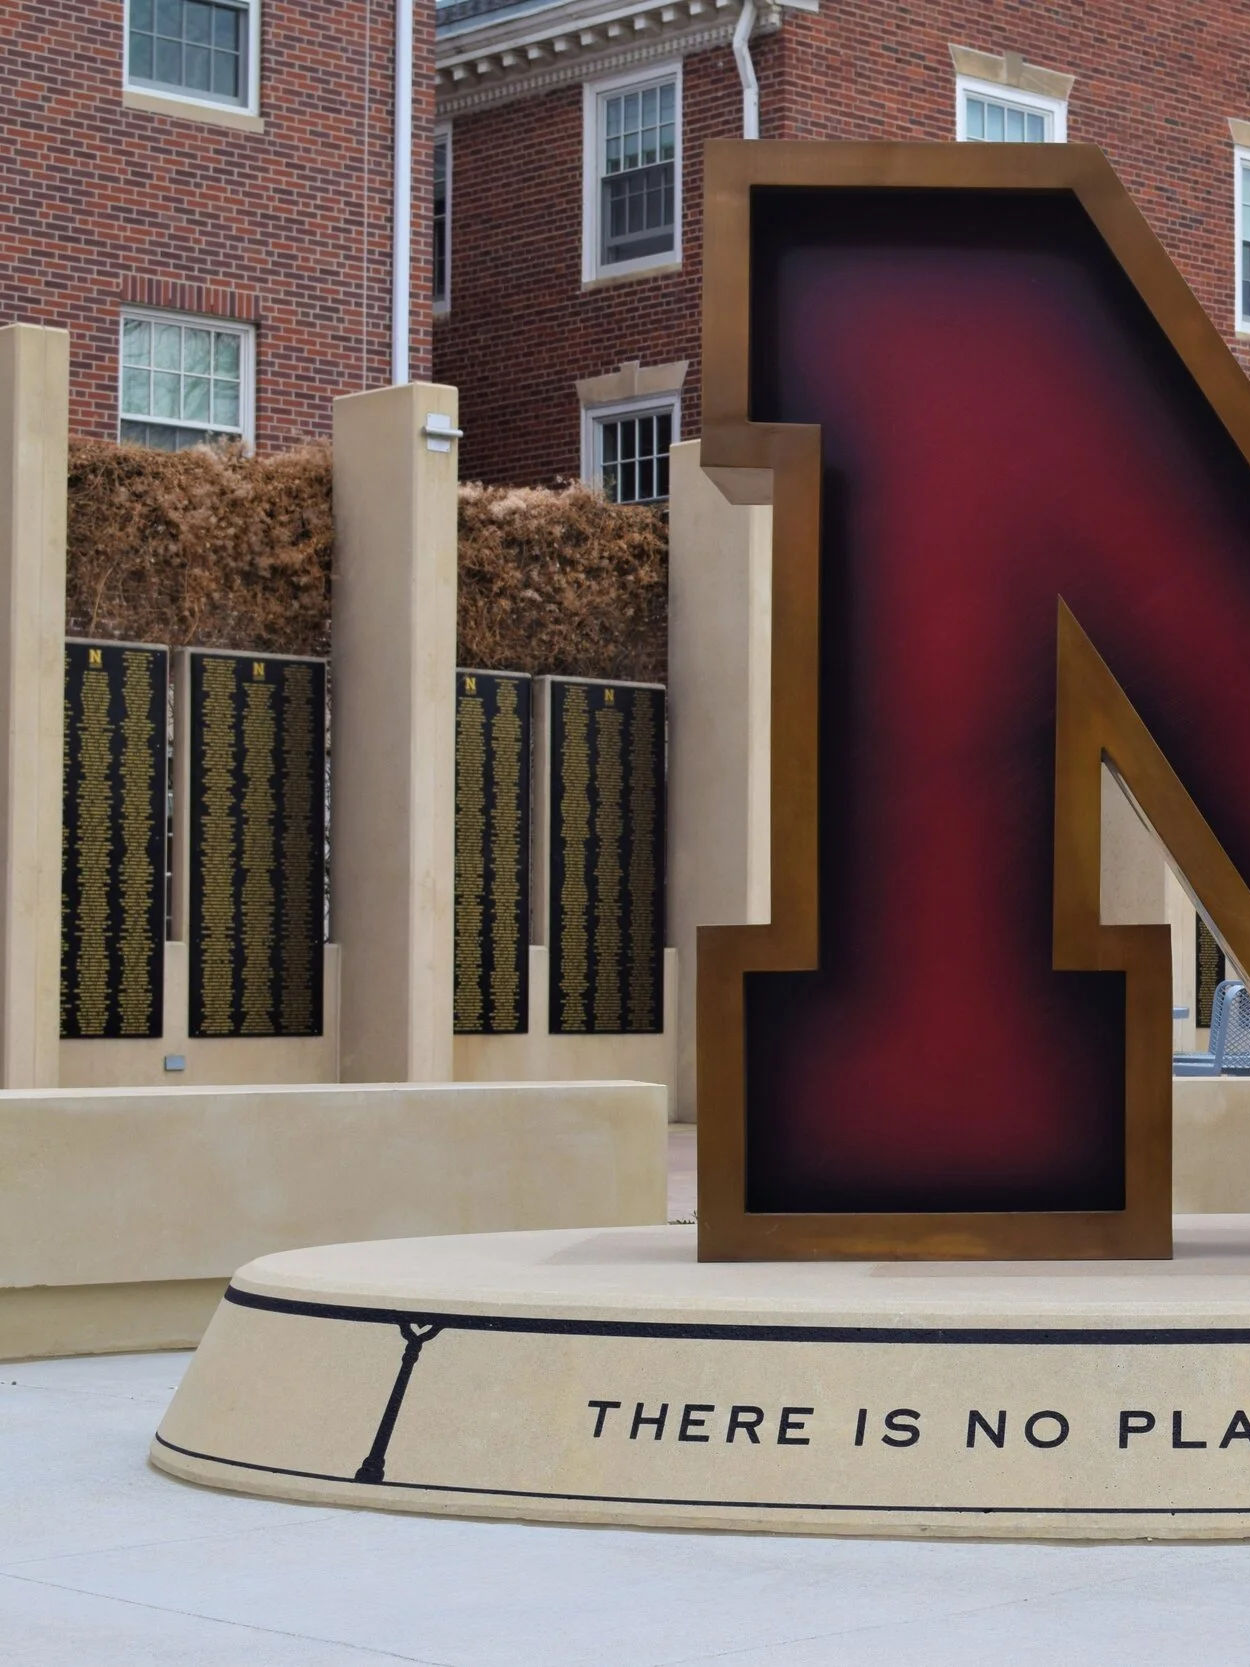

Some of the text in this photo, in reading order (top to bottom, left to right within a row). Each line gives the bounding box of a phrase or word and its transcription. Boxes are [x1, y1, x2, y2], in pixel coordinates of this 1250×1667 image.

[89, 649, 102, 663] N
[253, 662, 265, 676] N
[465, 677, 476, 690] N
[605, 688, 615, 701] N
[587, 1400, 815, 1446] THERE
[854, 1408, 921, 1448] IS
[966, 1409, 1070, 1449] NO
